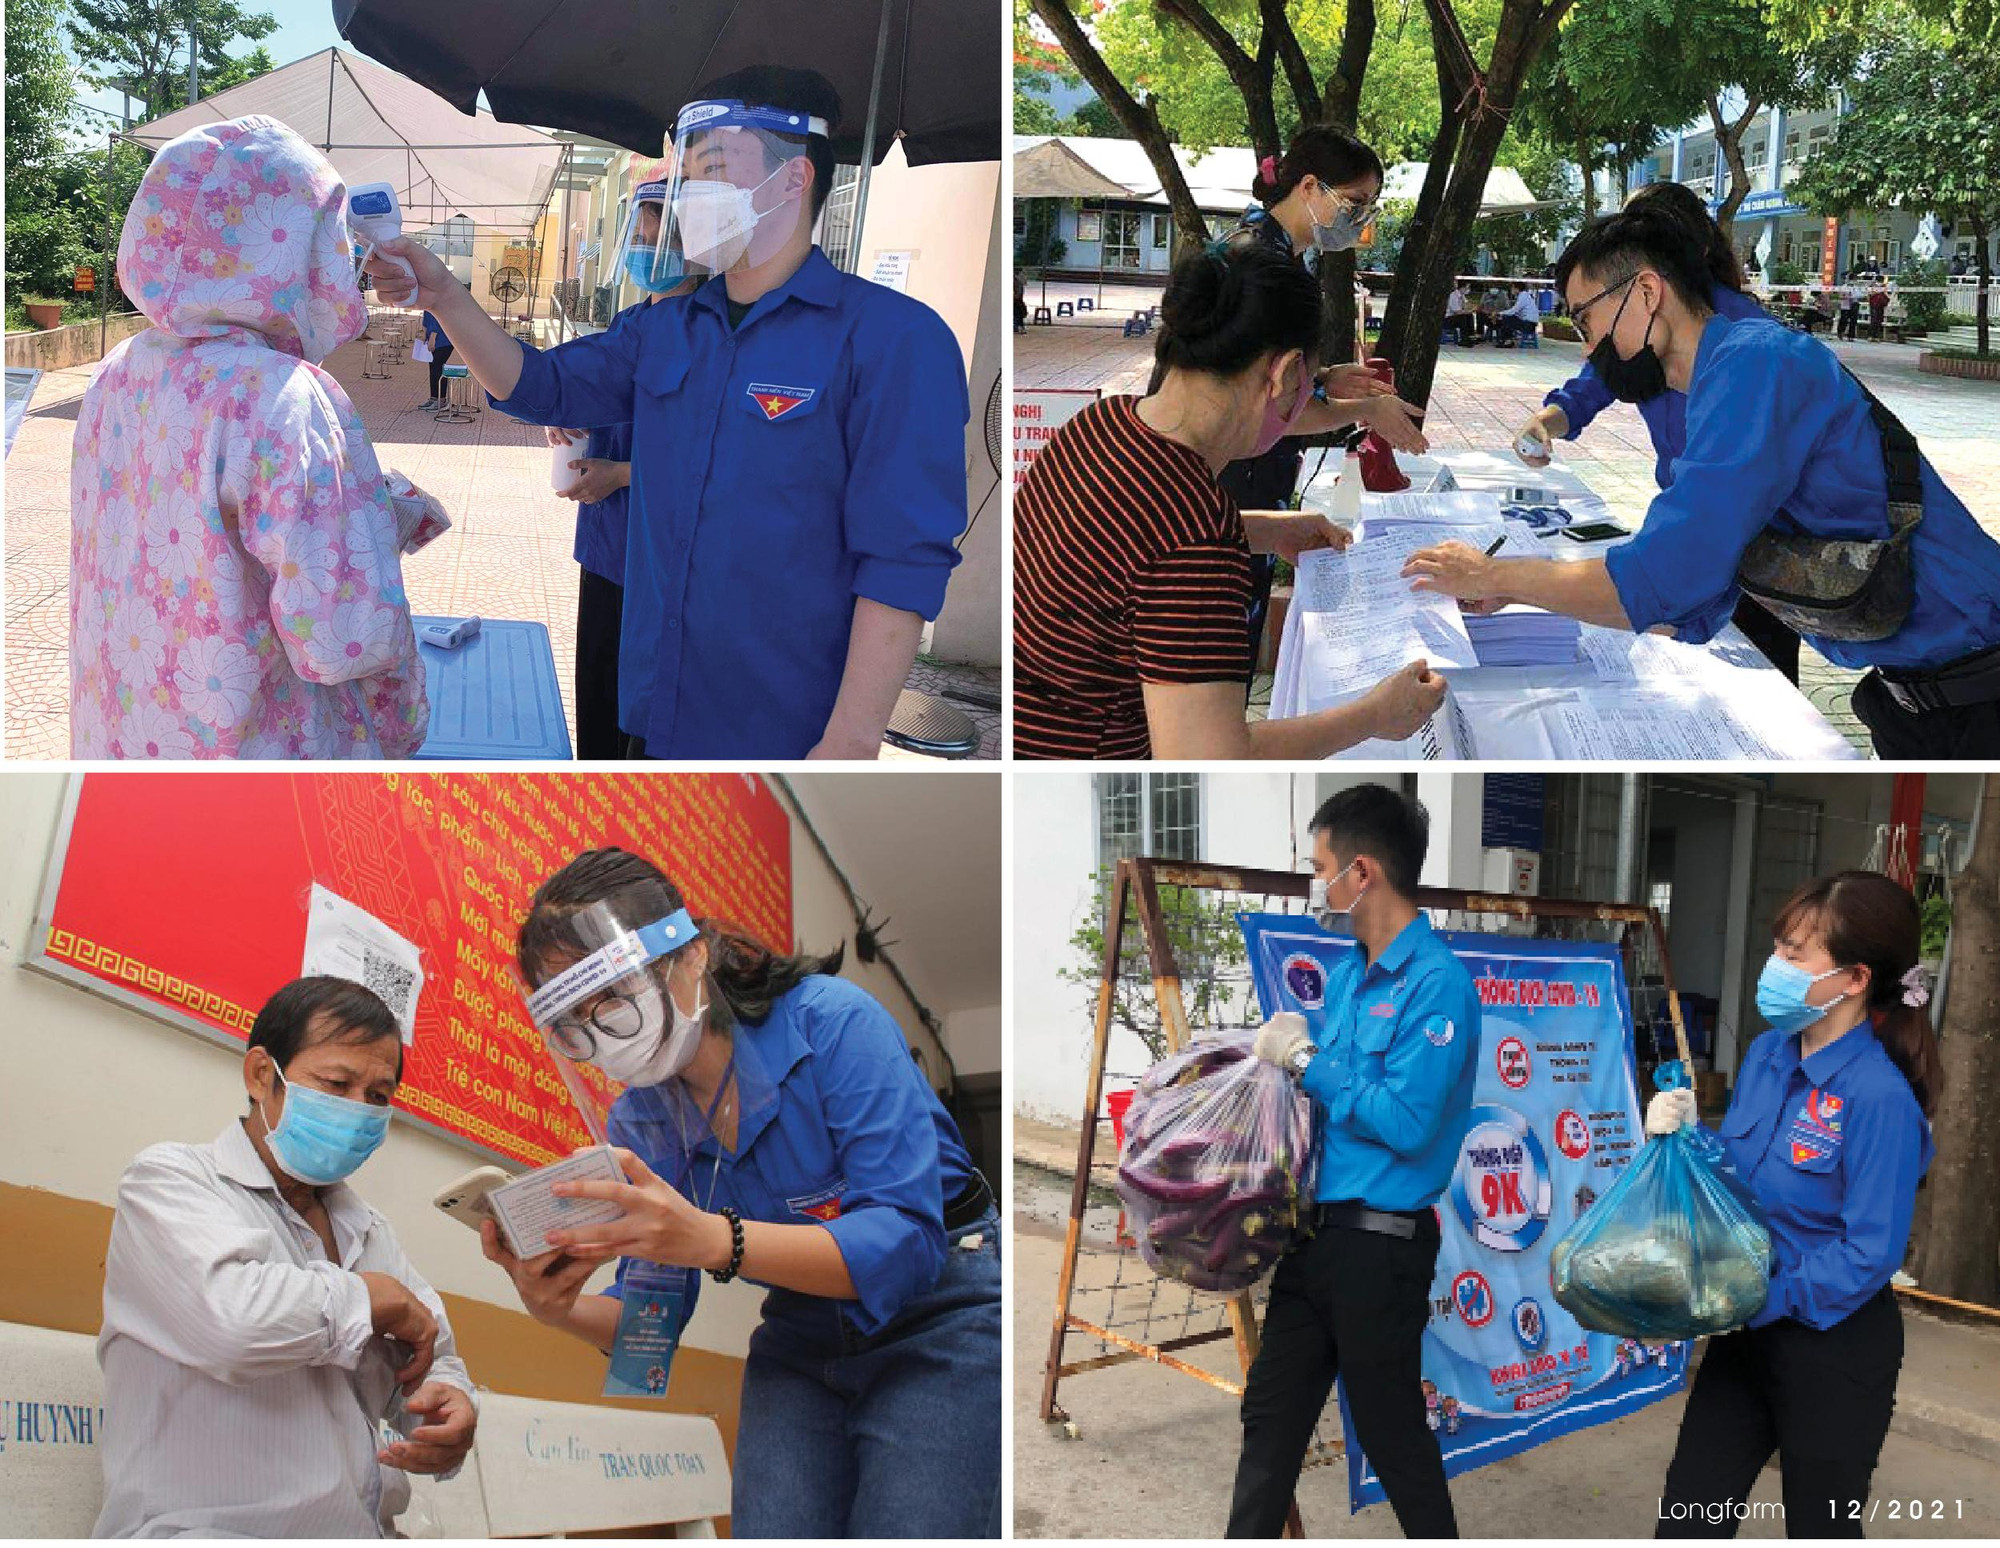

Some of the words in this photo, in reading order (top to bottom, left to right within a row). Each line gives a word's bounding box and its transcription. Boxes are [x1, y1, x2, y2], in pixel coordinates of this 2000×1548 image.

[691, 107, 713, 122] Shield
[653, 184, 667, 193] Shie
[464, 865, 504, 910] Quốc
[456, 938, 491, 980] Mấy
[453, 978, 495, 1021] Được
[497, 1010, 543, 1054] phong
[449, 1016, 483, 1055] Thật
[486, 1037, 501, 1065] là
[504, 1052, 532, 1082] một
[446, 1057, 469, 1089] Trẻ
[472, 1078, 503, 1107] con
[505, 1089, 539, 1124] Nam
[542, 1107, 568, 1140] Việt
[1481, 1172, 1527, 1218] 9K
[1490, 1363, 1529, 1385] KHAI
[17, 1402, 93, 1444] HUYNH
